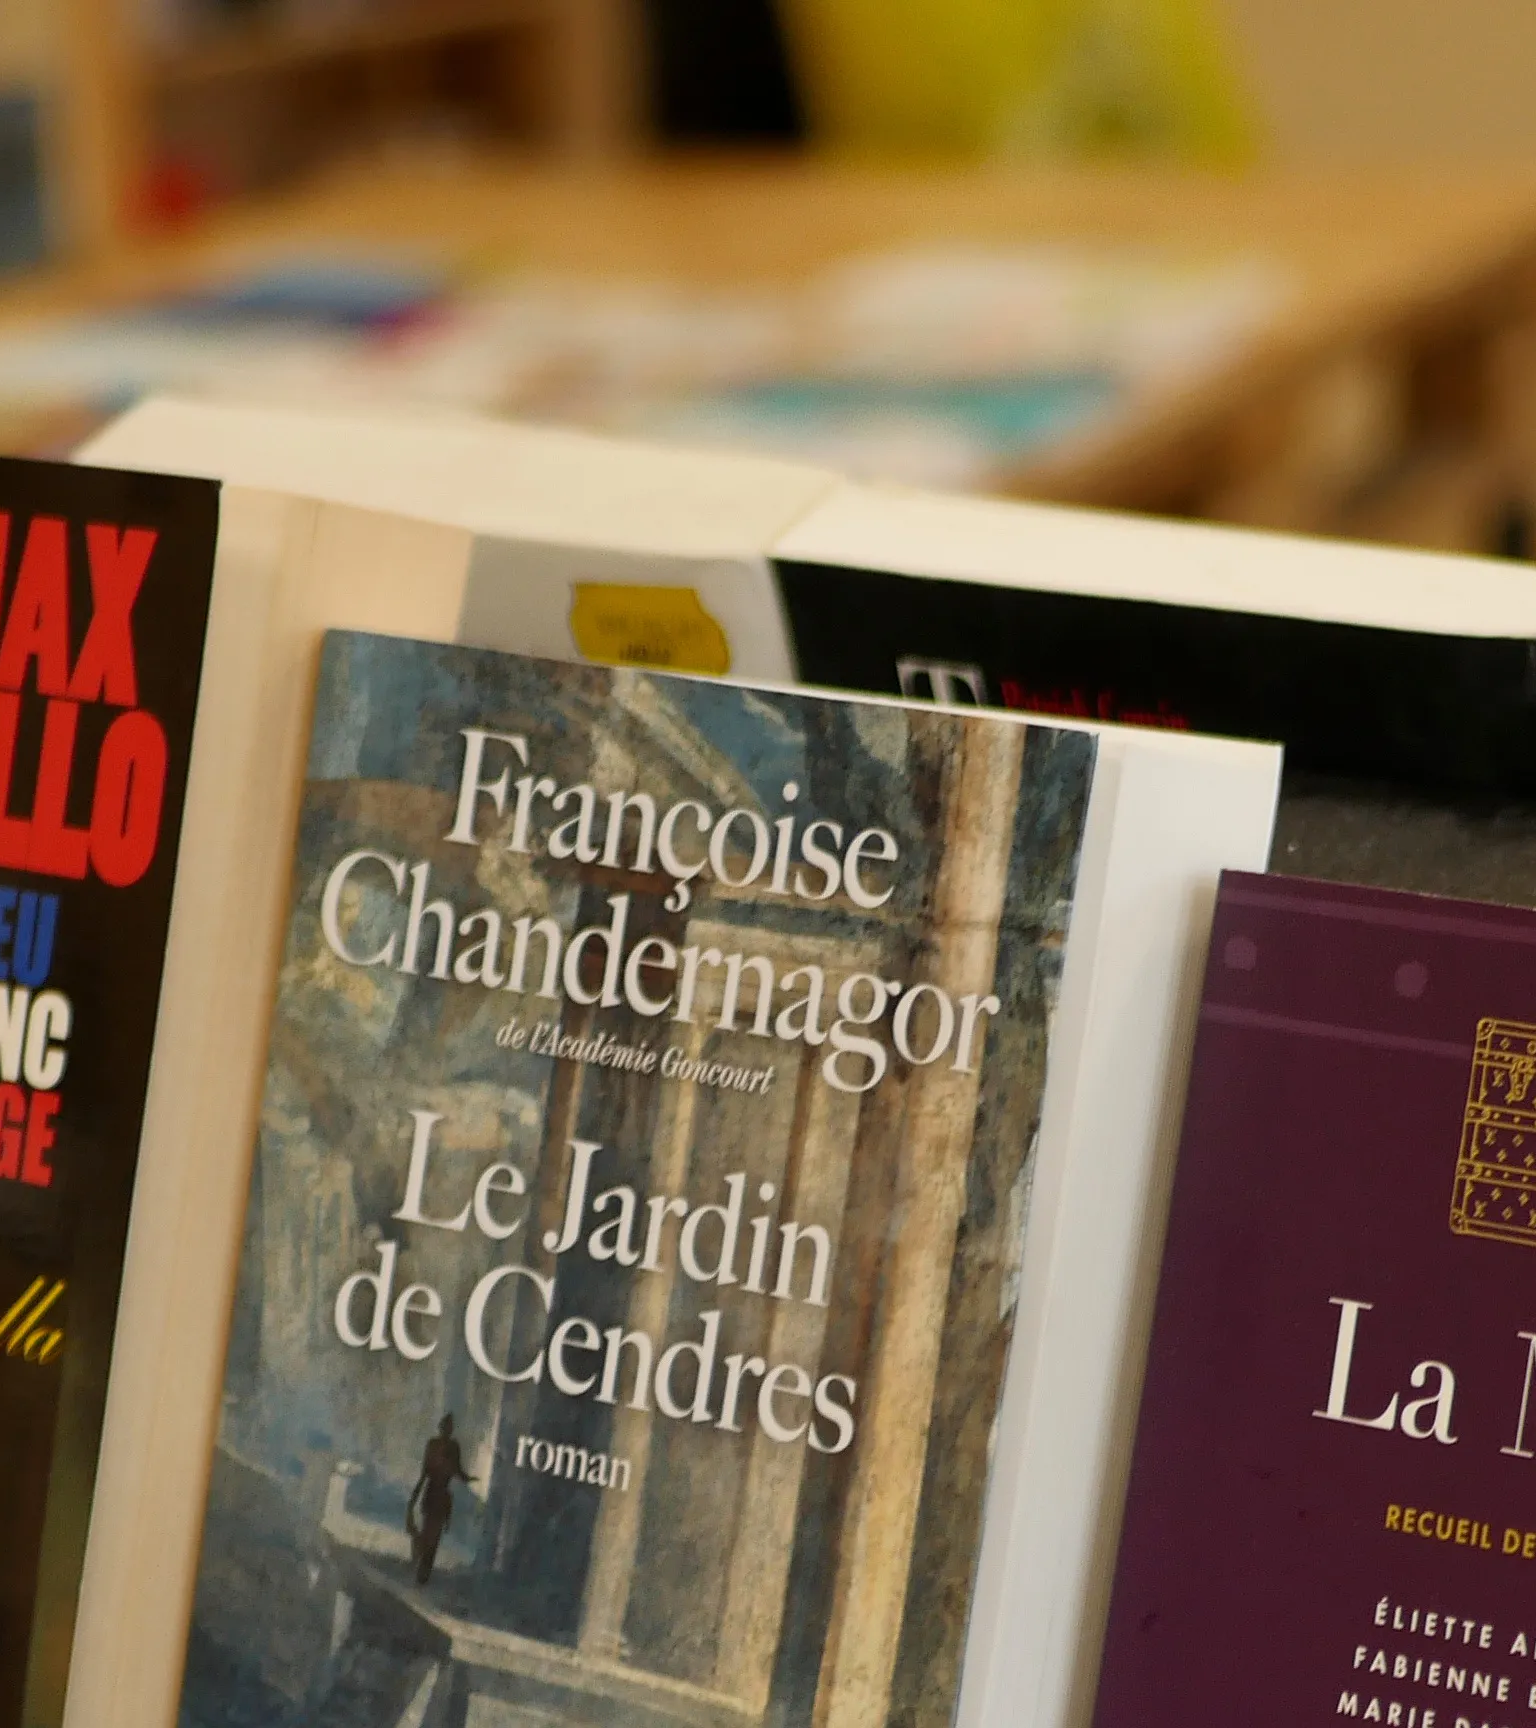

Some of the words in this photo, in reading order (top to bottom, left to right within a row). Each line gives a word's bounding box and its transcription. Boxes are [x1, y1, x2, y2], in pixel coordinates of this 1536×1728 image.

[444, 727, 900, 914] Françoise
[319, 848, 1002, 1094] Chandernagor
[495, 1019, 526, 1051] de
[530, 1022, 657, 1076] l'Académie
[660, 1048, 775, 1097] Goncourt
[394, 1108, 530, 1242] Le
[542, 1139, 835, 1309] Jardin
[334, 1241, 443, 1360] de
[465, 1263, 859, 1456] Cendres
[1312, 1296, 1459, 1445] La
[513, 1427, 634, 1492] roman
[1384, 1504, 1495, 1554] RECUEIL
[1352, 1644, 1513, 1703] FABIENNE
[1372, 1596, 1496, 1650] ÉLIETTE
